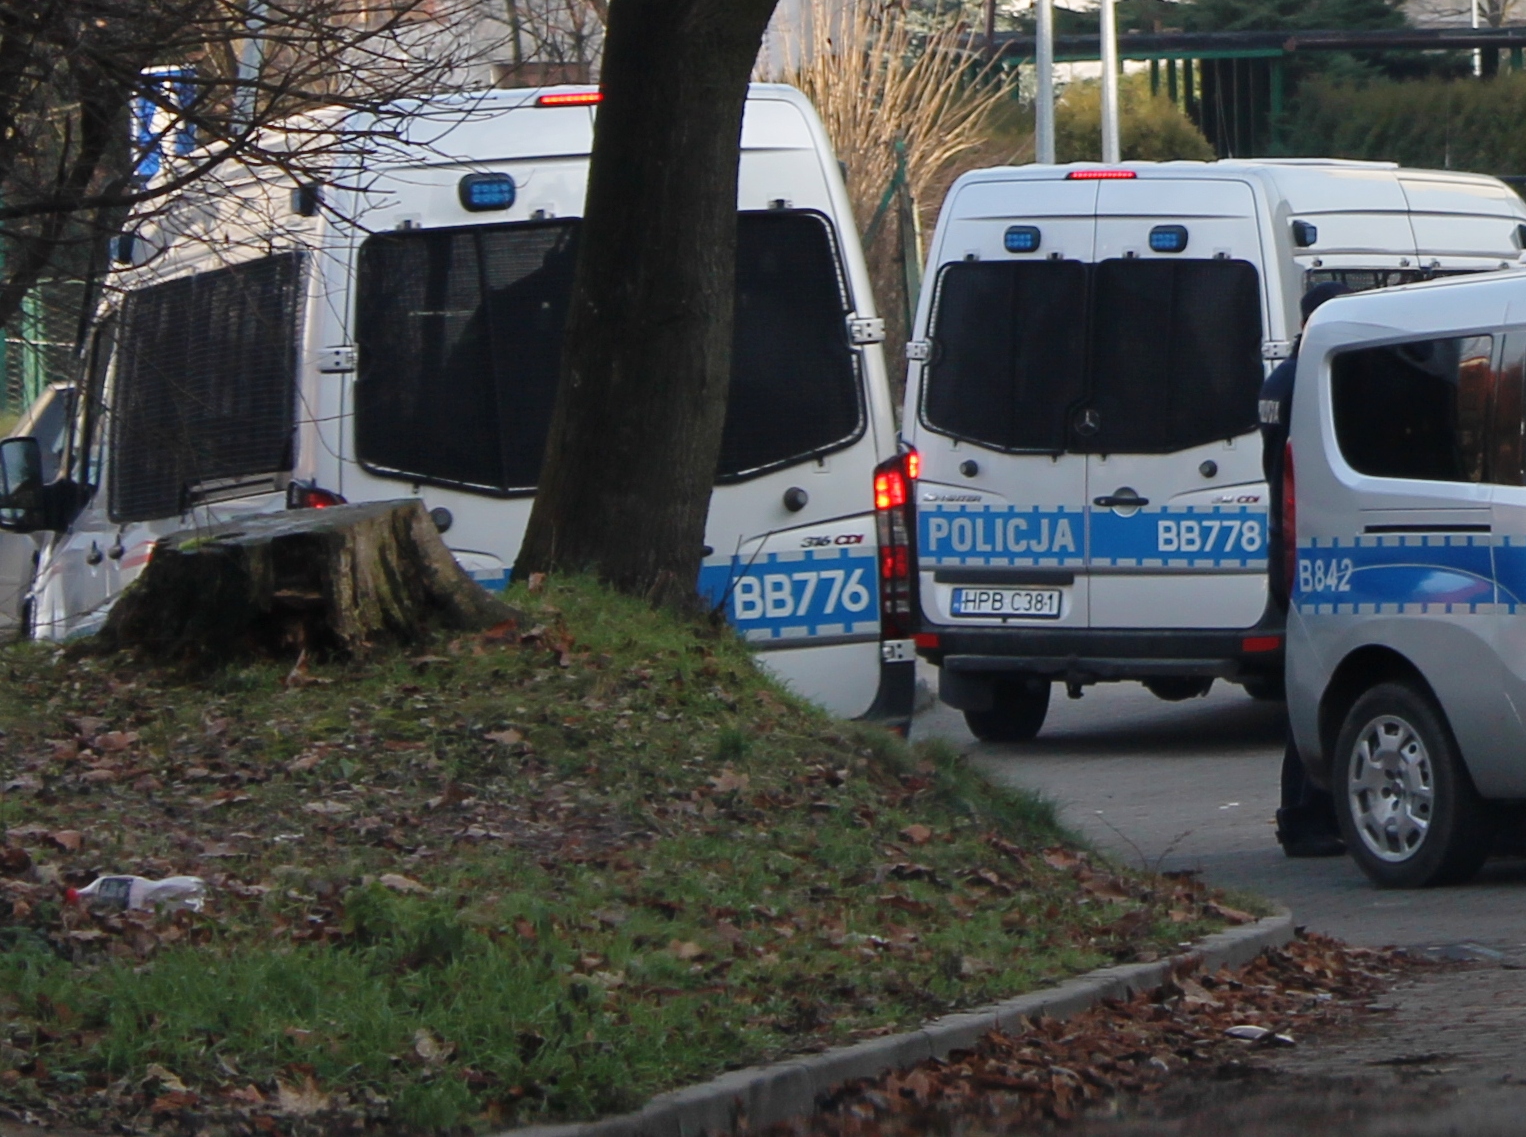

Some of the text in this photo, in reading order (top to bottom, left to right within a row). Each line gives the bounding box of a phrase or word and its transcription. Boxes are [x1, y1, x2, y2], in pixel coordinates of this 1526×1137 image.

[800, 534, 864, 548] 316 CDI
[928, 517, 1076, 553] POLICJA
[1157, 519, 1262, 553] BB778
[1299, 558, 1353, 593] B842
[732, 568, 870, 621] BB776
[963, 591, 1053, 612] HPB C381
